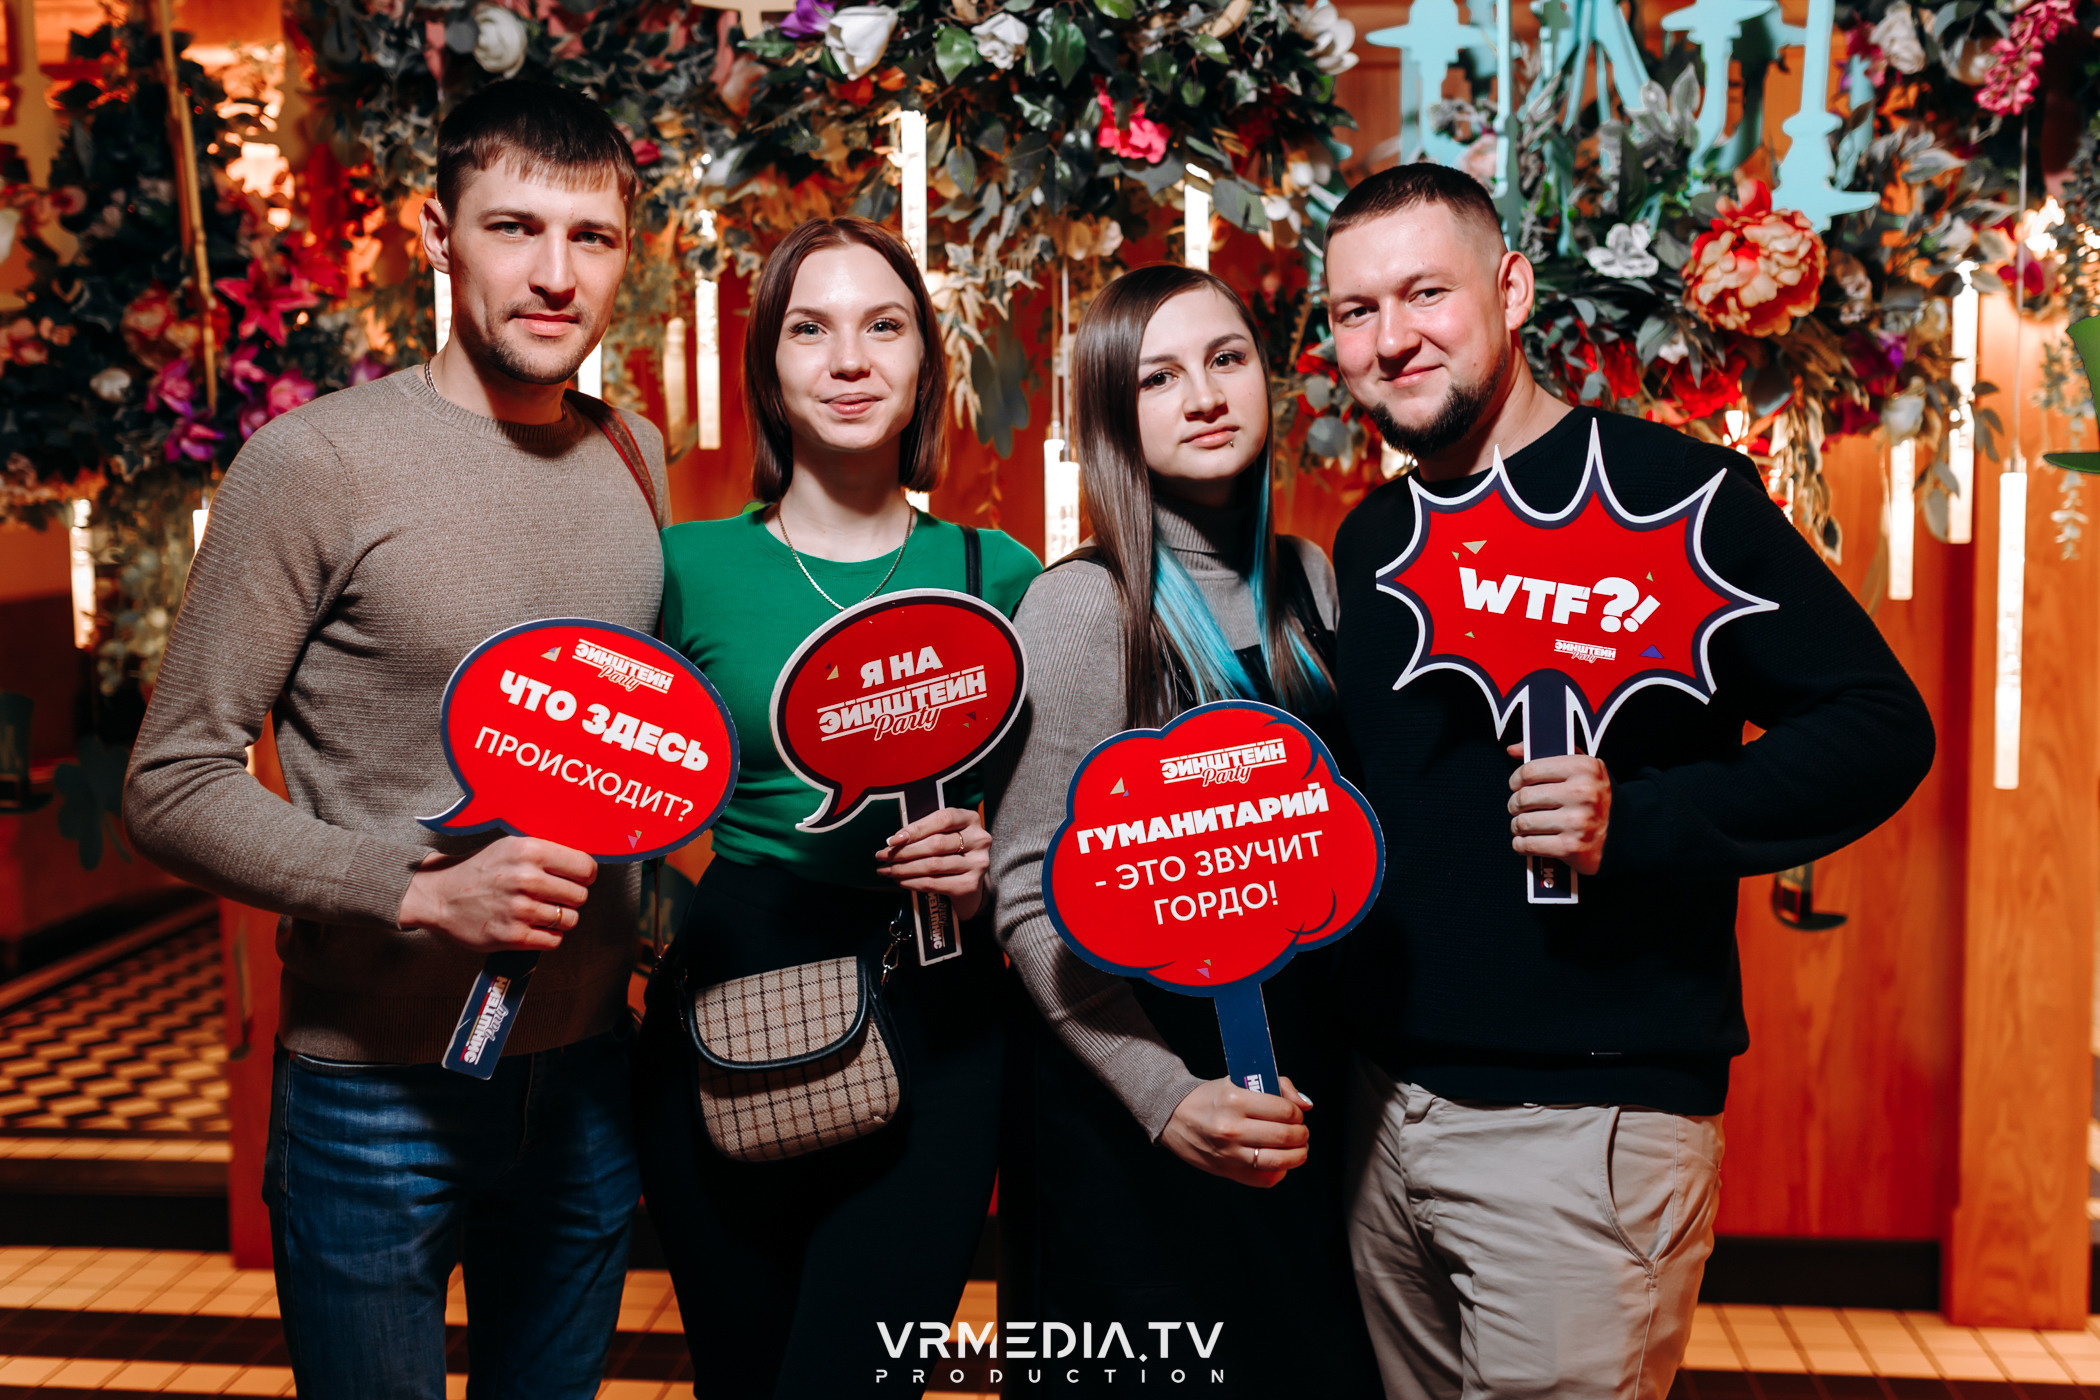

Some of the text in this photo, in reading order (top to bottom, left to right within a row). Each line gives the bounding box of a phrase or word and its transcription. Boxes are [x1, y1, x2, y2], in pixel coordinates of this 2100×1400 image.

[1459, 566, 1661, 633] WTF?!
[597, 664, 641, 692] Party
[860, 645, 943, 689] Я НА
[499, 669, 709, 772] ЧТО ЗДЕСЬ
[873, 703, 942, 741] Party
[474, 726, 694, 822] ПРОИСХОДИТ?
[1200, 765, 1252, 787] Party
[1077, 782, 1329, 854] ГУМАНИТАРИЙ
[1115, 855, 1186, 890] ЭТО
[1194, 830, 1323, 877] ЗВУЧИТ
[1153, 880, 1279, 925] ГОРДО!
